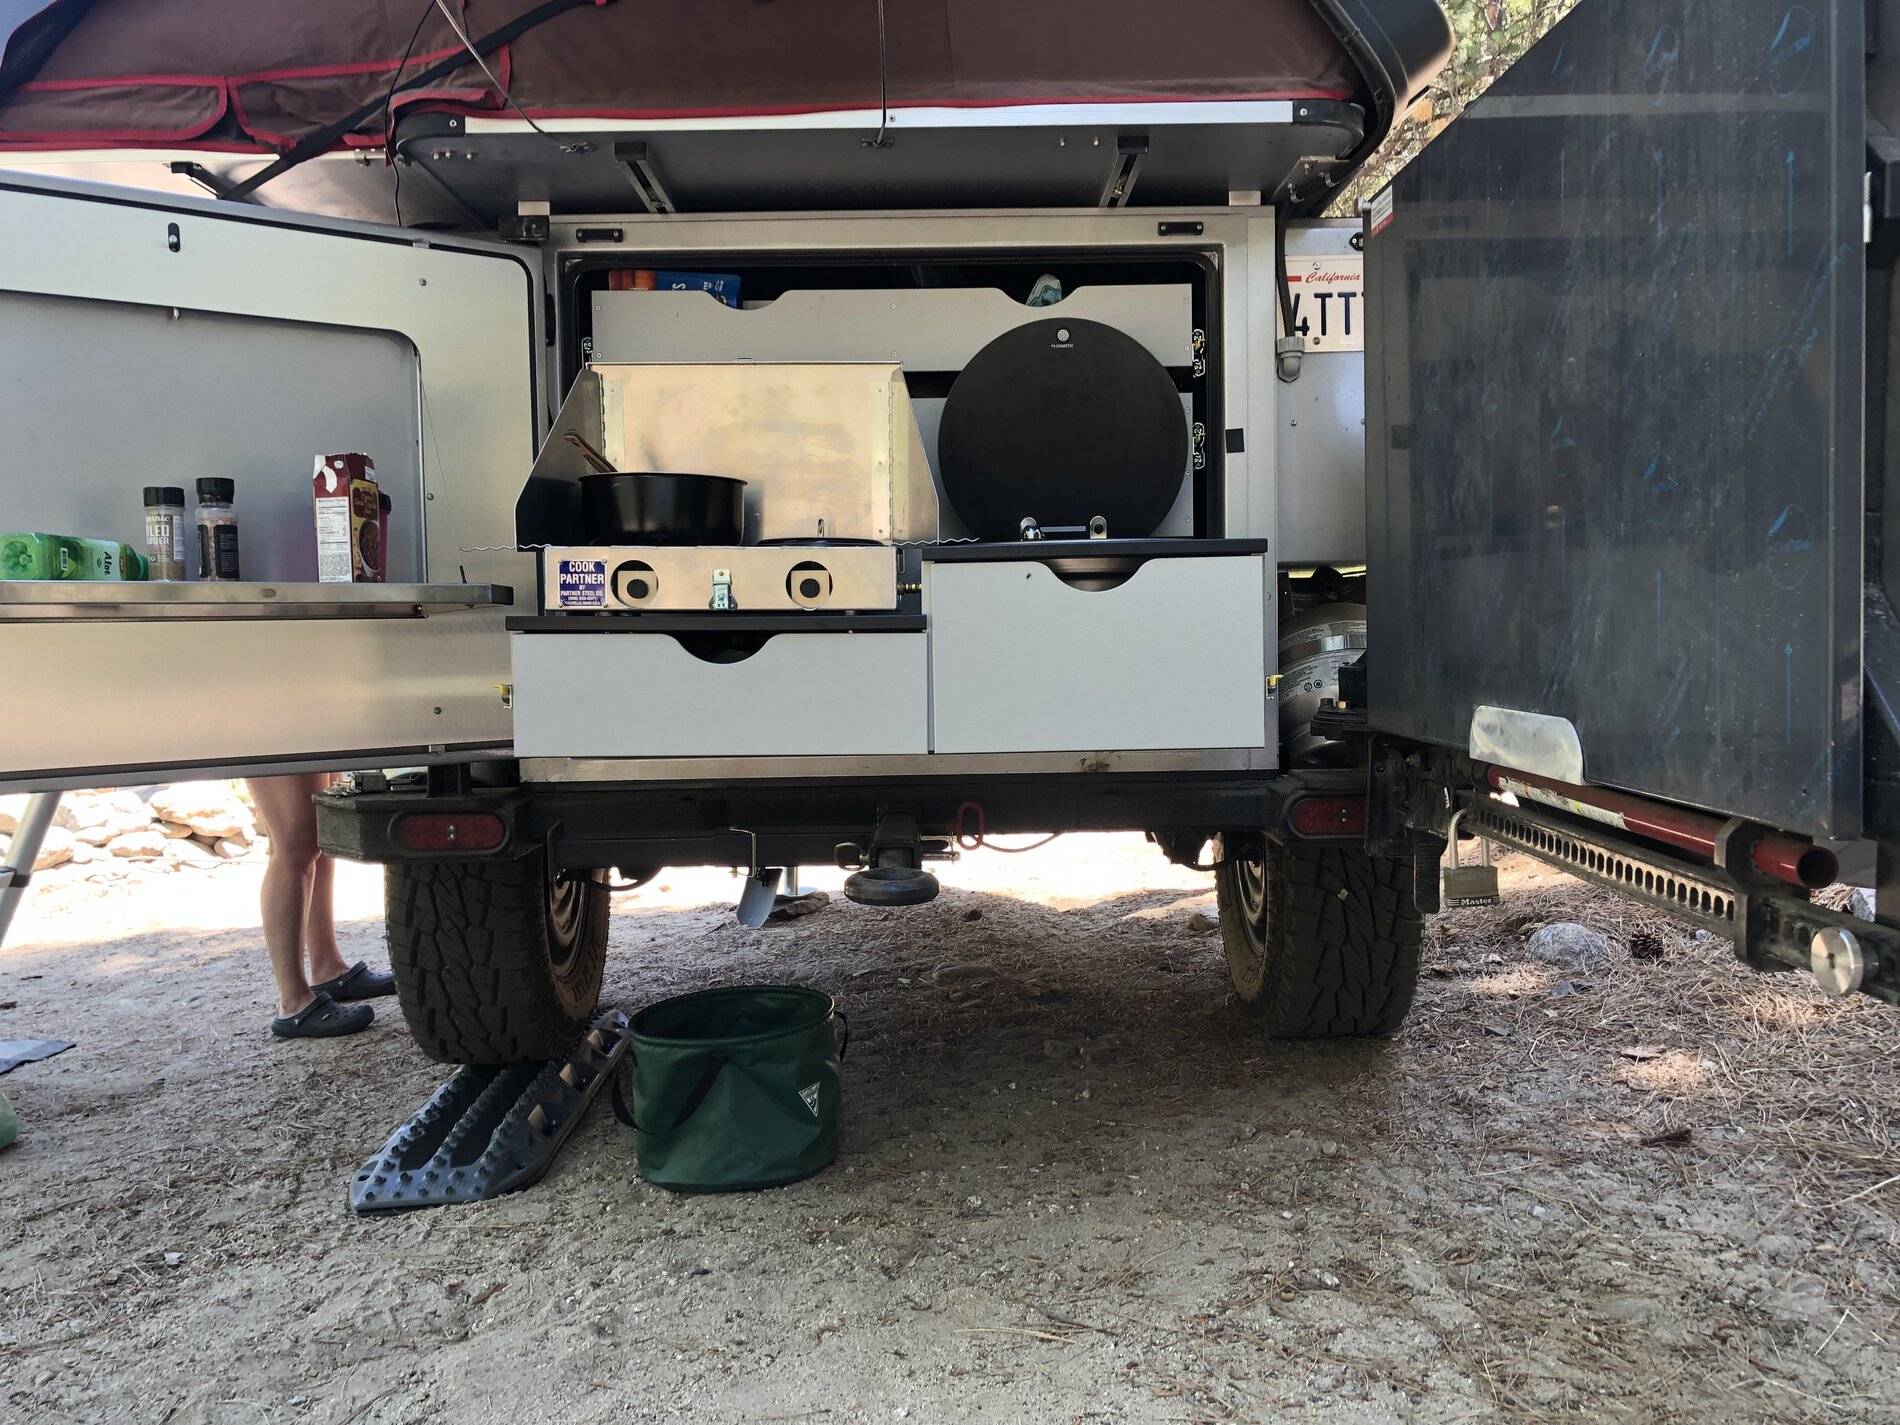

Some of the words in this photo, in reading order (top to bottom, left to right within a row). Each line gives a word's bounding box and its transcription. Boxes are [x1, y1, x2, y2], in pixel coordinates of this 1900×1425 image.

[1306, 271, 1361, 284] California
[1292, 291, 1365, 336] 4TT
[569, 561, 596, 572] COOK
[560, 573, 605, 584] PARTNER
[1460, 898, 1492, 906] Master
